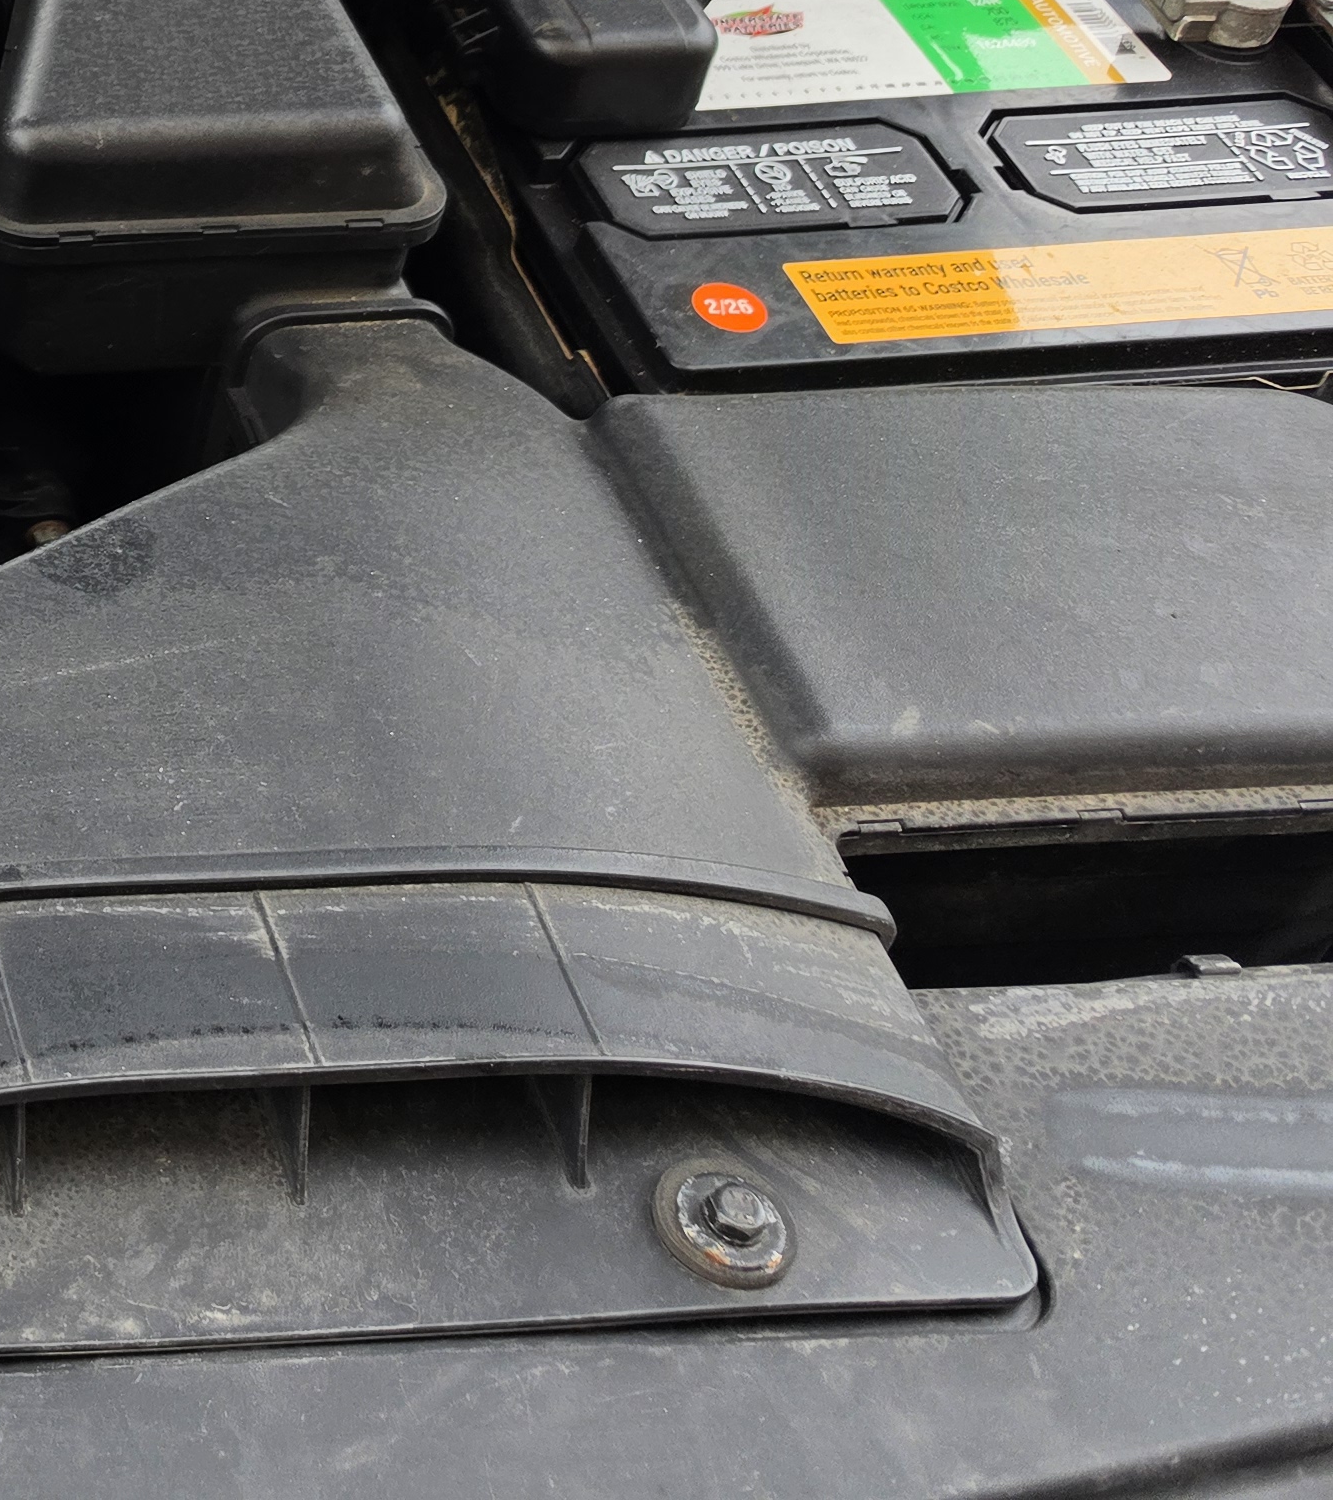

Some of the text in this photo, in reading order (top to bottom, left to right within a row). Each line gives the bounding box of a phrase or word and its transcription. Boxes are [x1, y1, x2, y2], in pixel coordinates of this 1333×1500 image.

[714, 10, 802, 27] INTERSTATE
[721, 21, 802, 36] BATTERIES
[663, 144, 753, 163] DANGER
[772, 137, 858, 156] POISON
[889, 173, 918, 185] ACID
[798, 255, 1034, 284] Return warranty and used
[811, 271, 1090, 302] batteries to Costco Wholesale
[1252, 287, 1280, 300] Pb
[704, 298, 755, 316] 2/26
[828, 307, 902, 318] PROPOSITION
[917, 302, 972, 312] WARNING:
